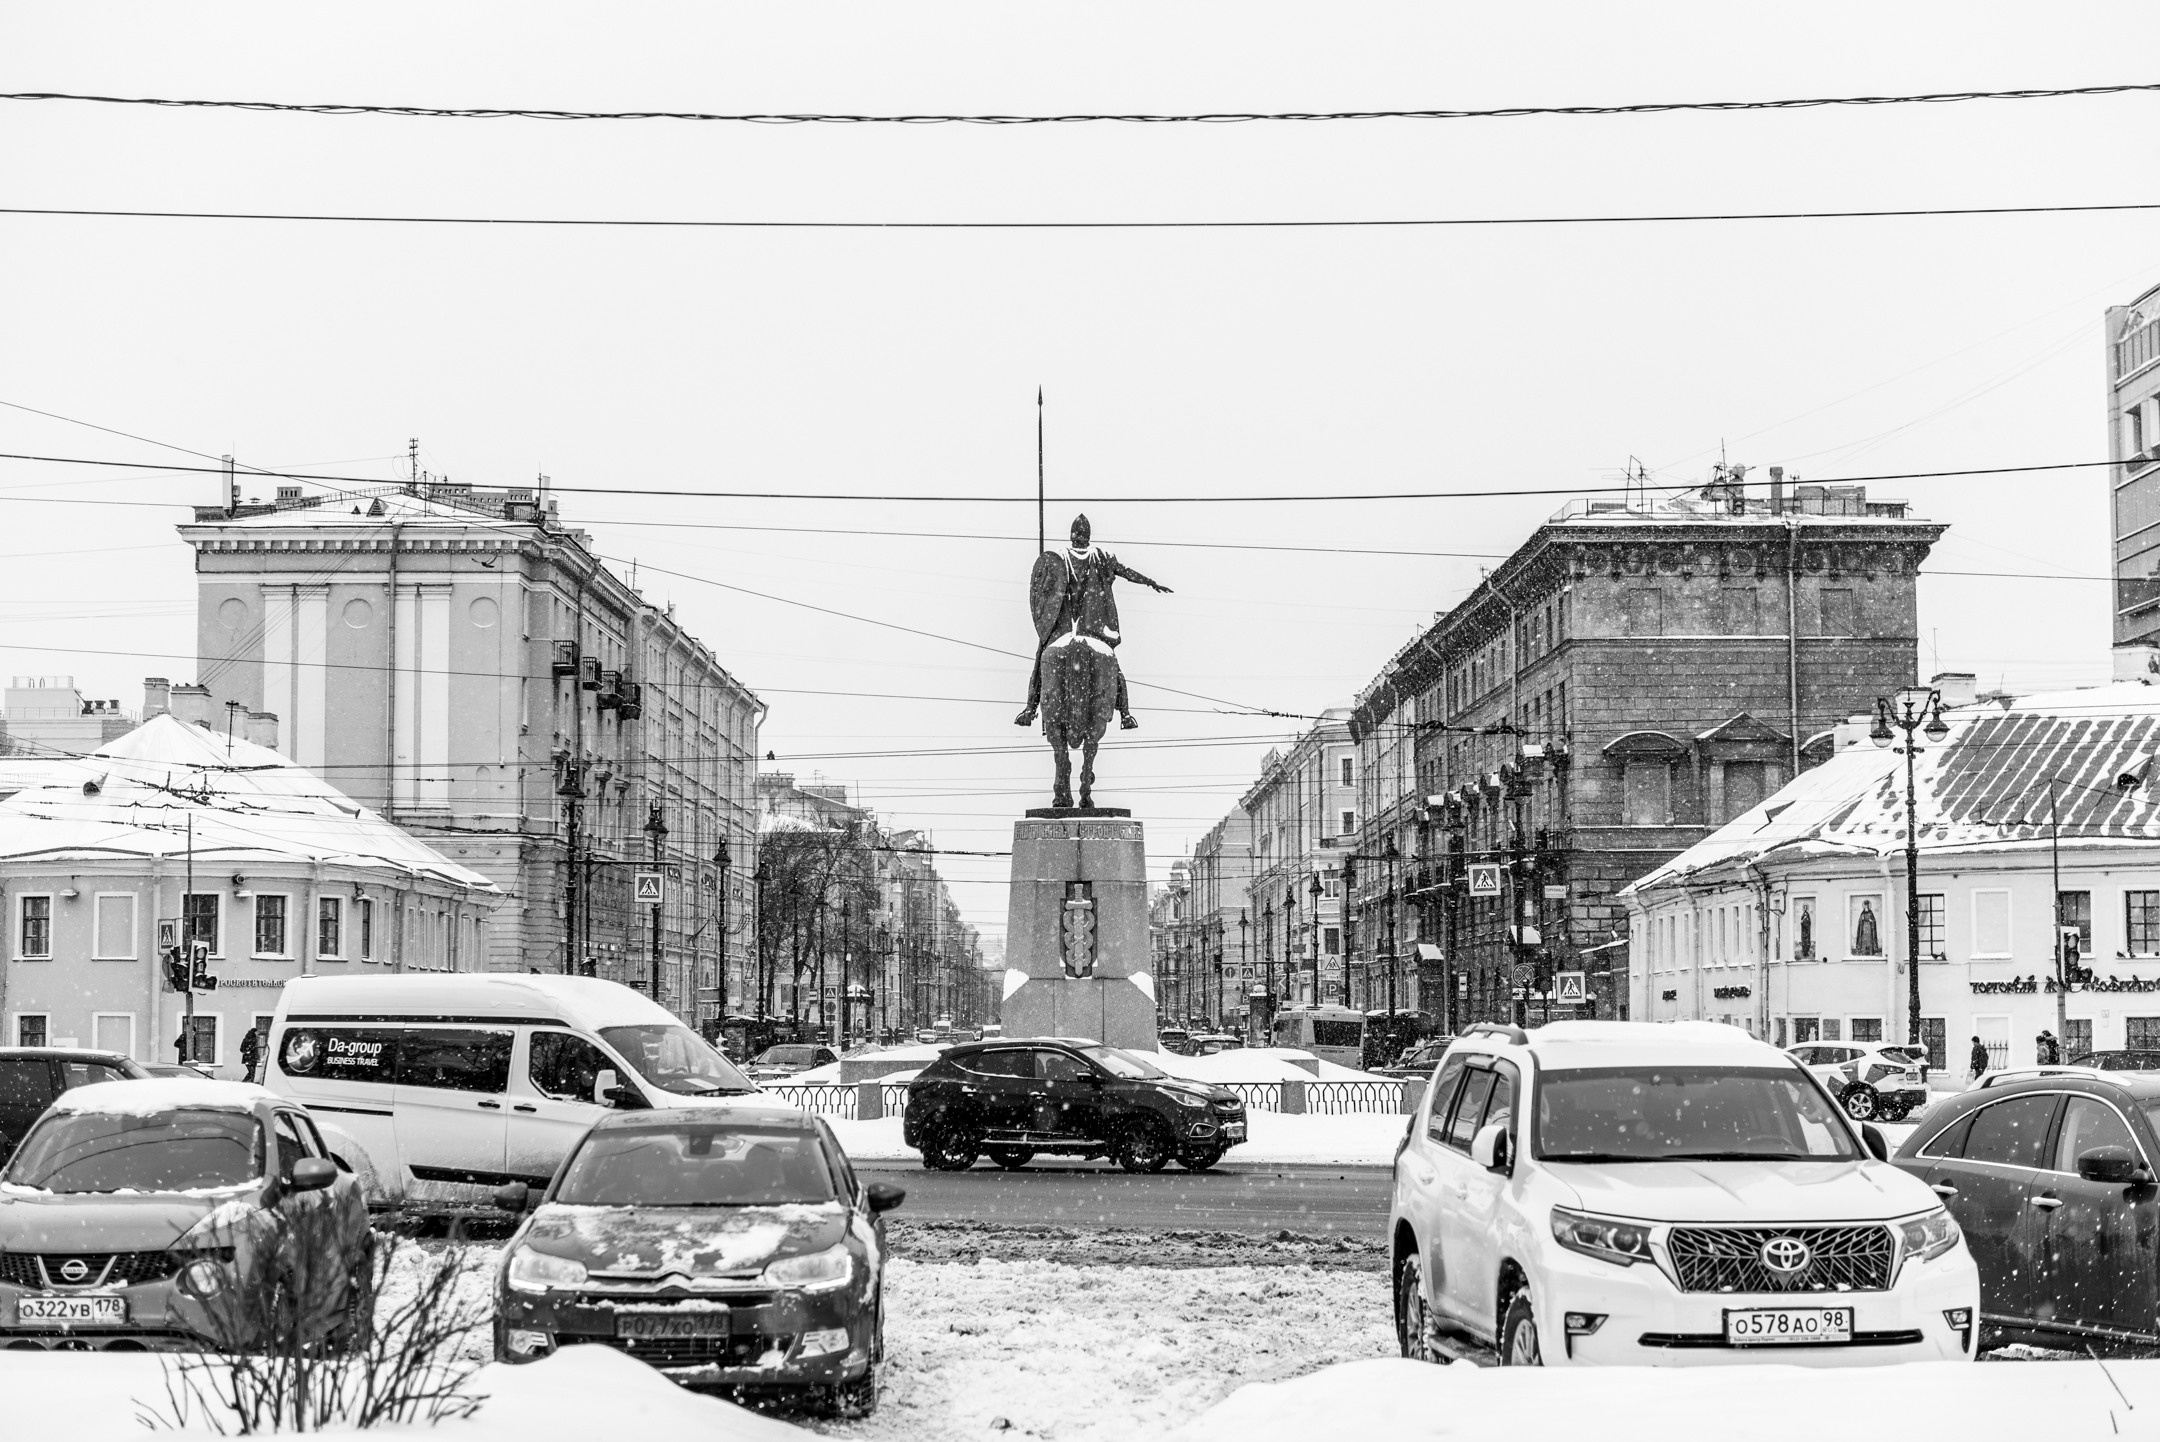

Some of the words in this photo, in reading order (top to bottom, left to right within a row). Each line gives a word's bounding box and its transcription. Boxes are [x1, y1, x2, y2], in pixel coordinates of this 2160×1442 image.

[327, 1037, 382, 1057] Da-group
[327, 1056, 356, 1066] BUSINESS
[357, 1057, 379, 1067] TRAVEL
[95, 1299, 120, 1313] 178
[1823, 1311, 1844, 1327] 98
